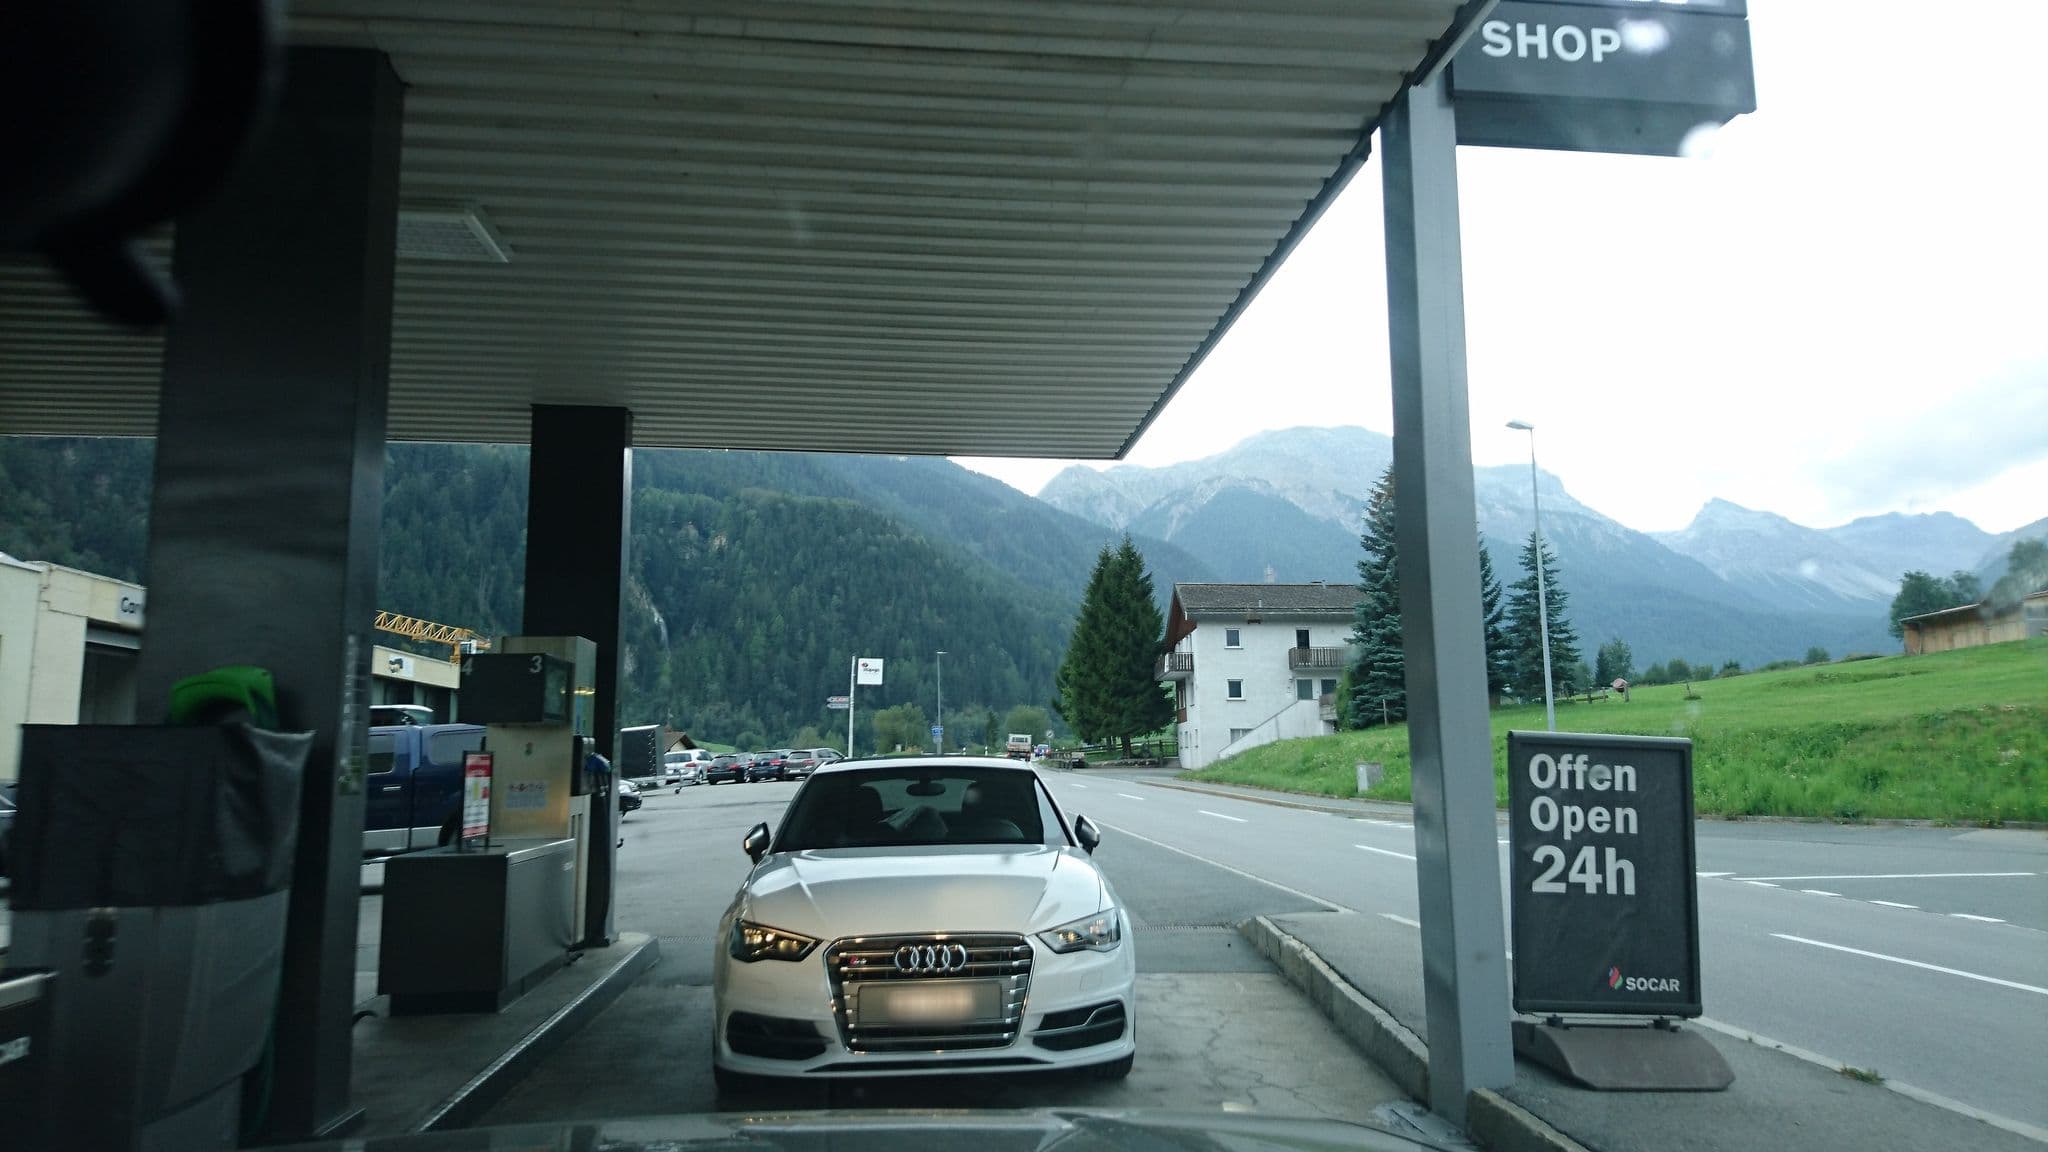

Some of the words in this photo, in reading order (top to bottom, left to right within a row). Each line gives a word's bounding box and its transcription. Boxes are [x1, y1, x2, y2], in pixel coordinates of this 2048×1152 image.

[1481, 20, 1622, 63] SHOP
[462, 657, 474, 676] 4
[529, 655, 543, 673] 3
[1528, 753, 1638, 792] Offen
[1529, 795, 1639, 841] Open
[1531, 844, 1637, 896] 24h
[1625, 977, 1681, 993] SOCAR
